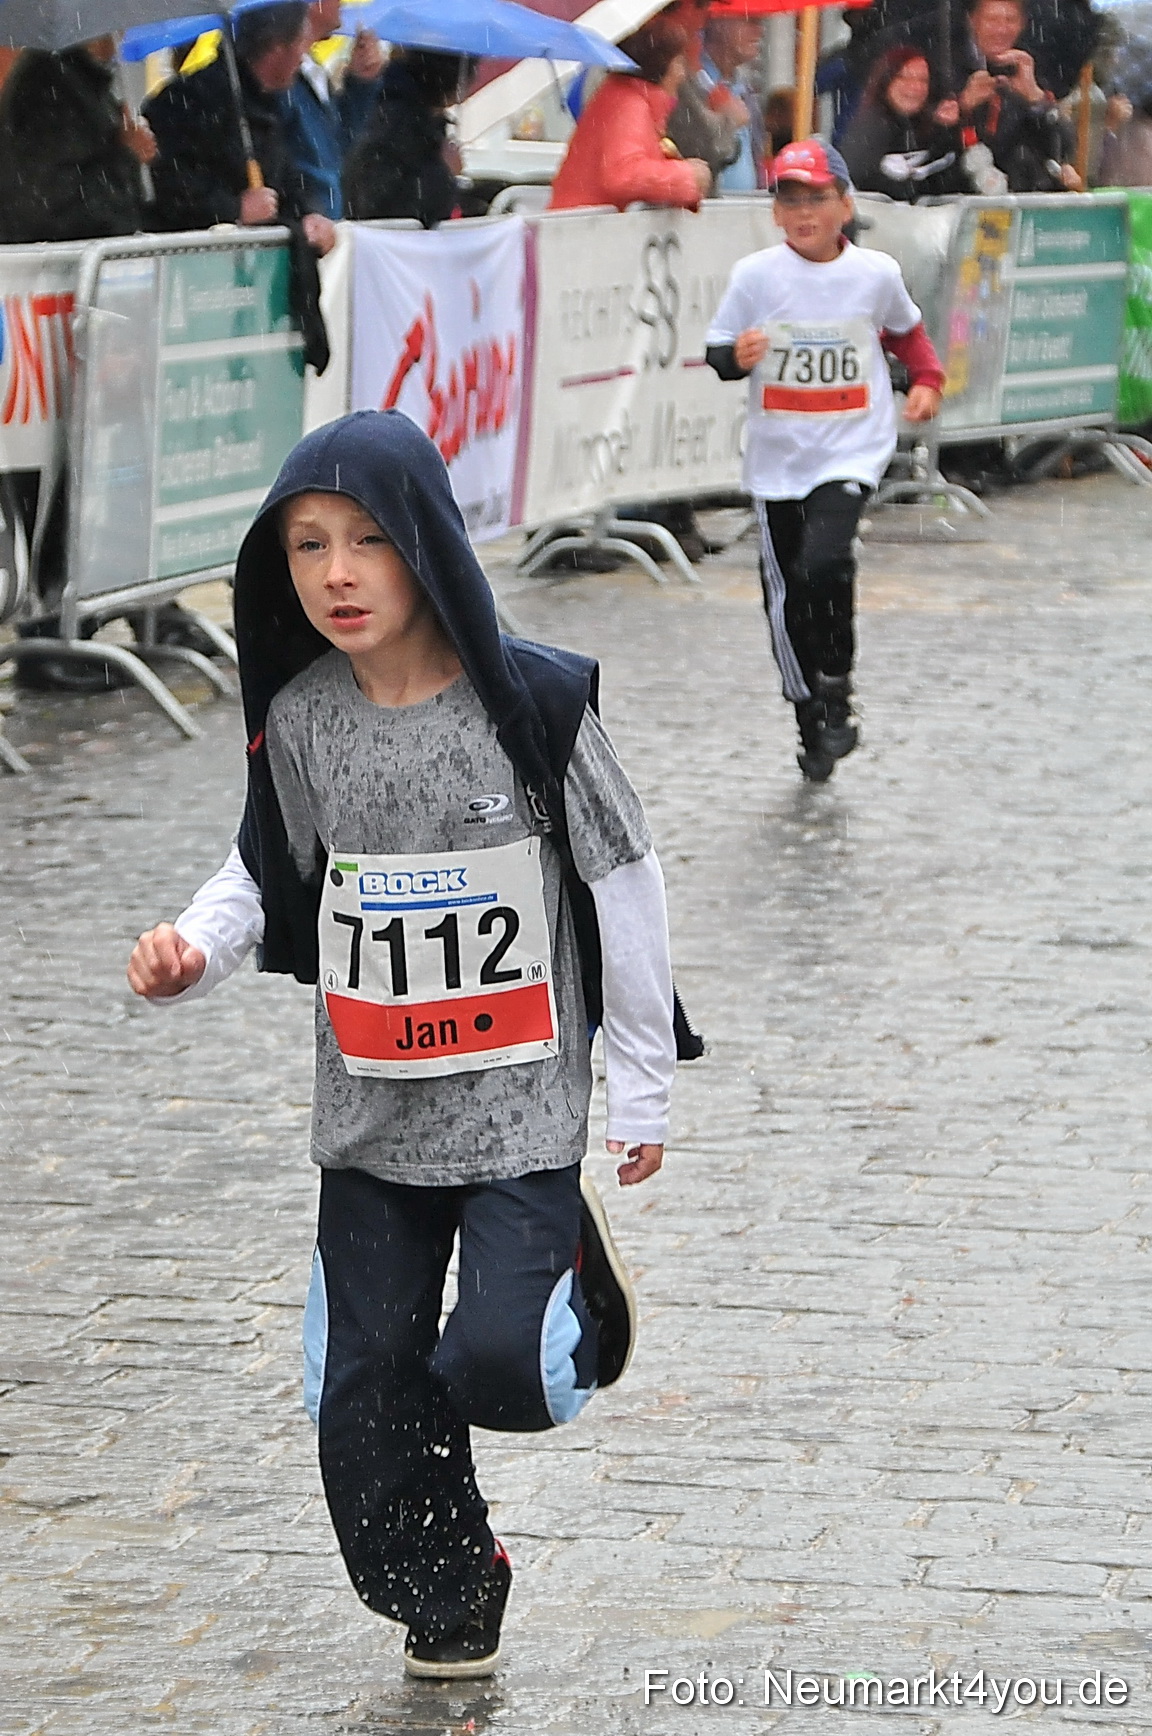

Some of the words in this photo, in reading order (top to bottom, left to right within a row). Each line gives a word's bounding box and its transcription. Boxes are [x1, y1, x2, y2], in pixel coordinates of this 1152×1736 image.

[773, 347, 858, 383] 7306
[359, 867, 467, 896] BOCK
[332, 906, 522, 997] 7112
[396, 1016, 458, 1051] Jan
